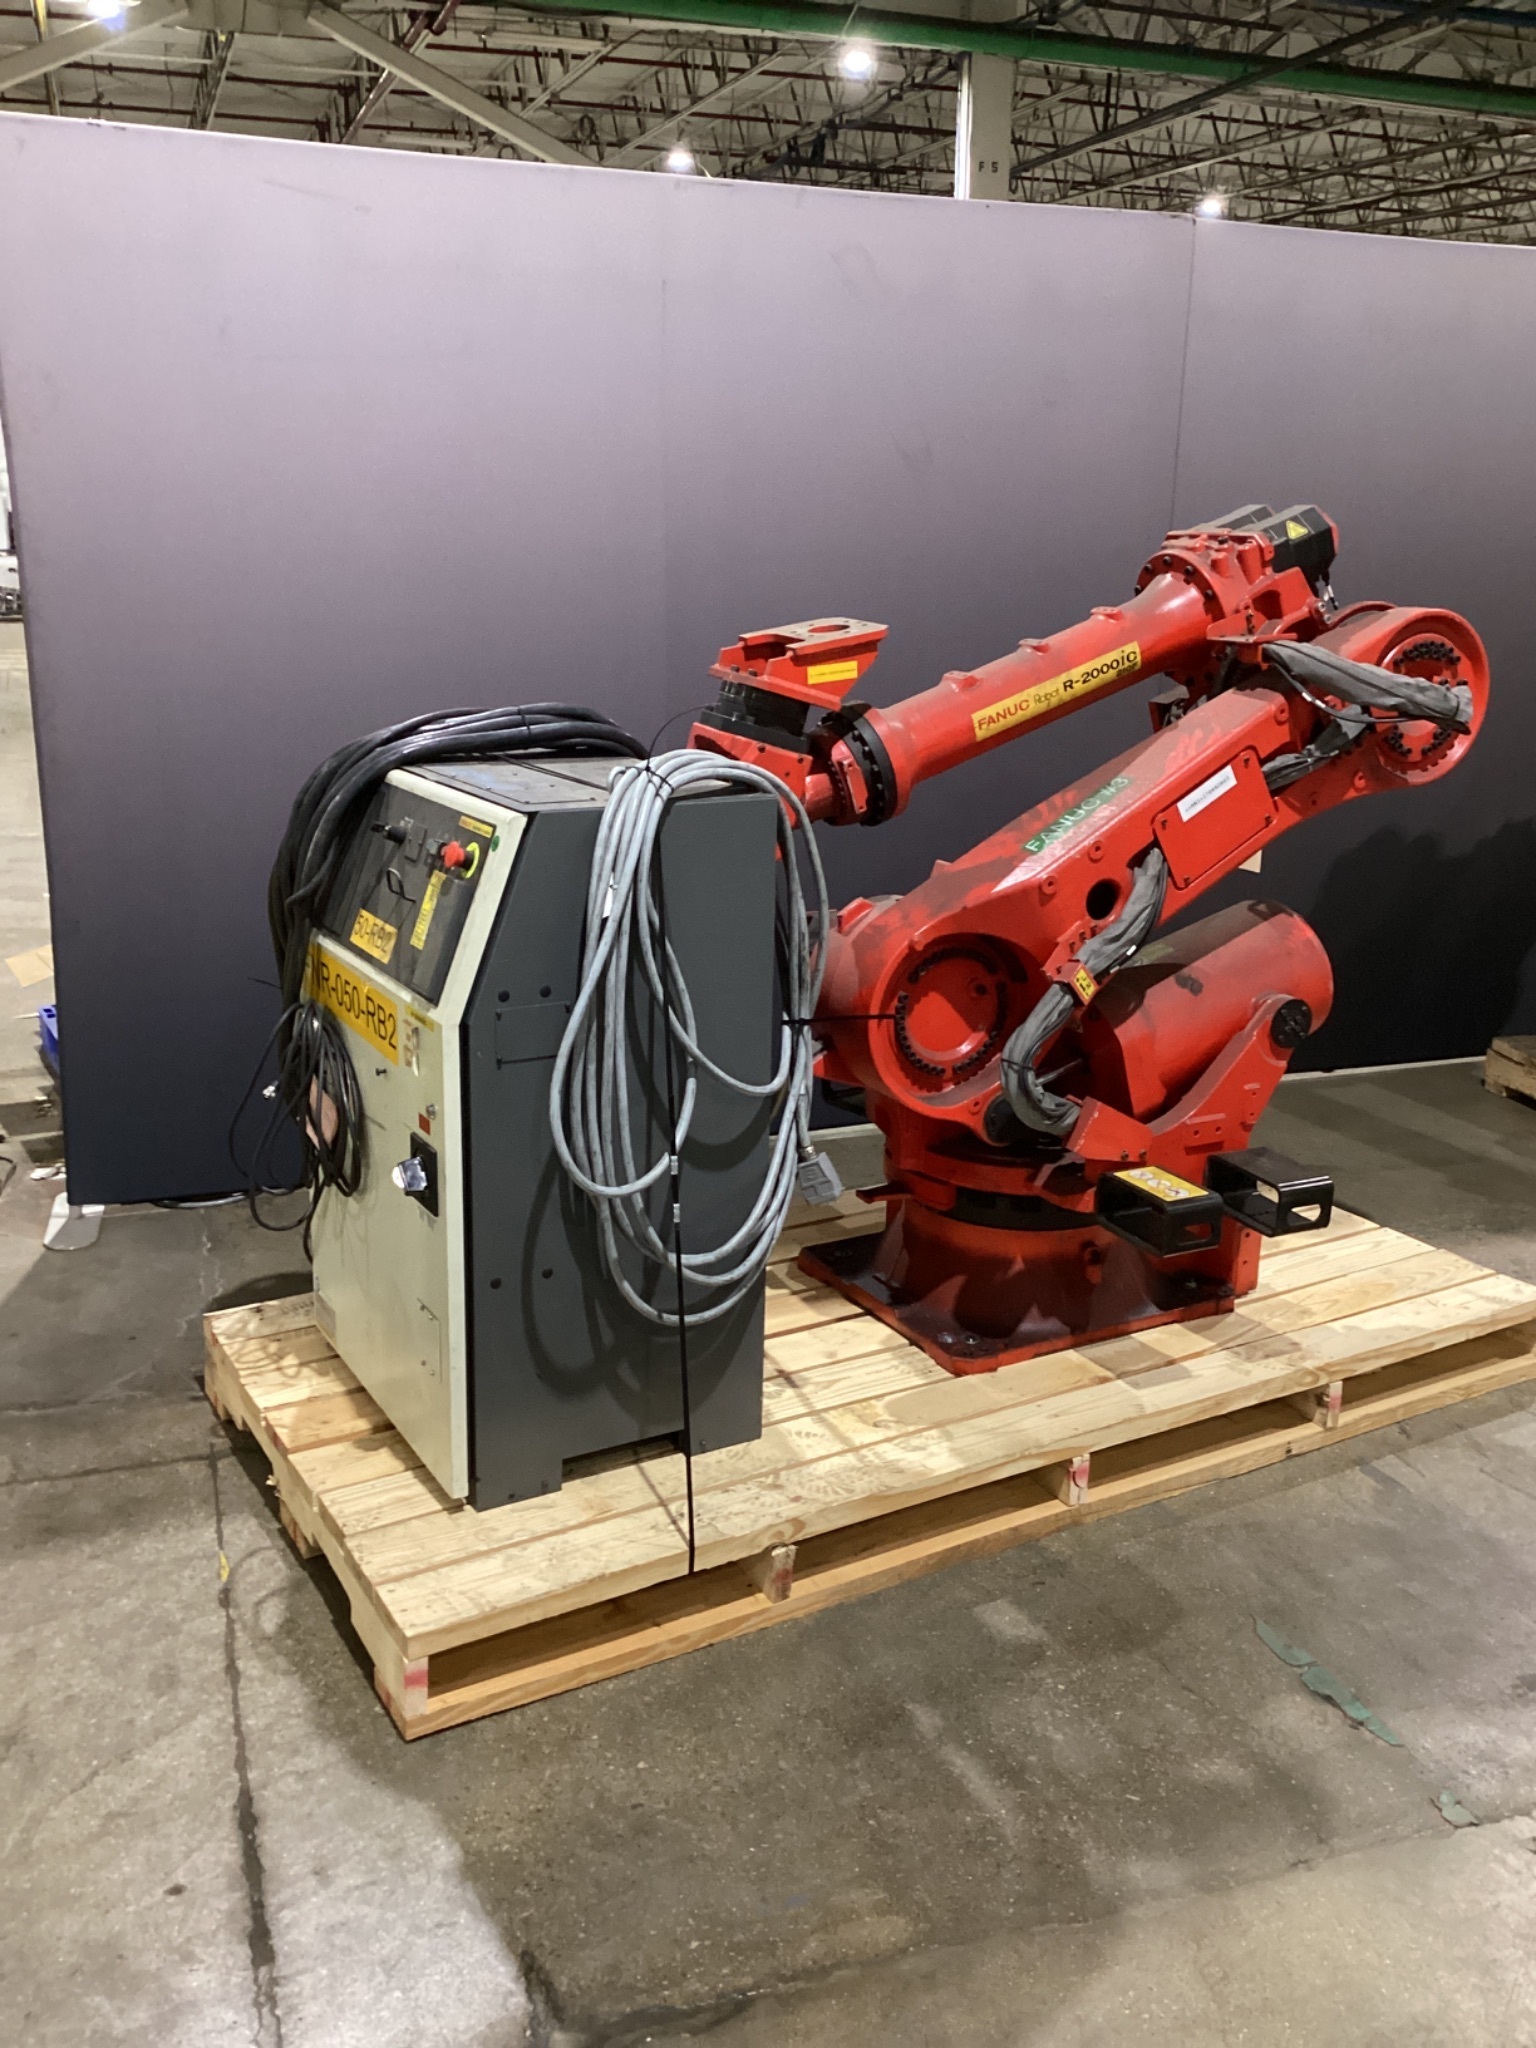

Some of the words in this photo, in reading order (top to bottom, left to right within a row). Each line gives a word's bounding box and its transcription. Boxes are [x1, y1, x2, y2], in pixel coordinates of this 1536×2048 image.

[979, 161, 985, 173] F
[977, 699, 1030, 731] FANUC
[1033, 687, 1060, 706] Robot
[1063, 649, 1138, 693] R-2000iC
[1024, 797, 1101, 852] FANUC
